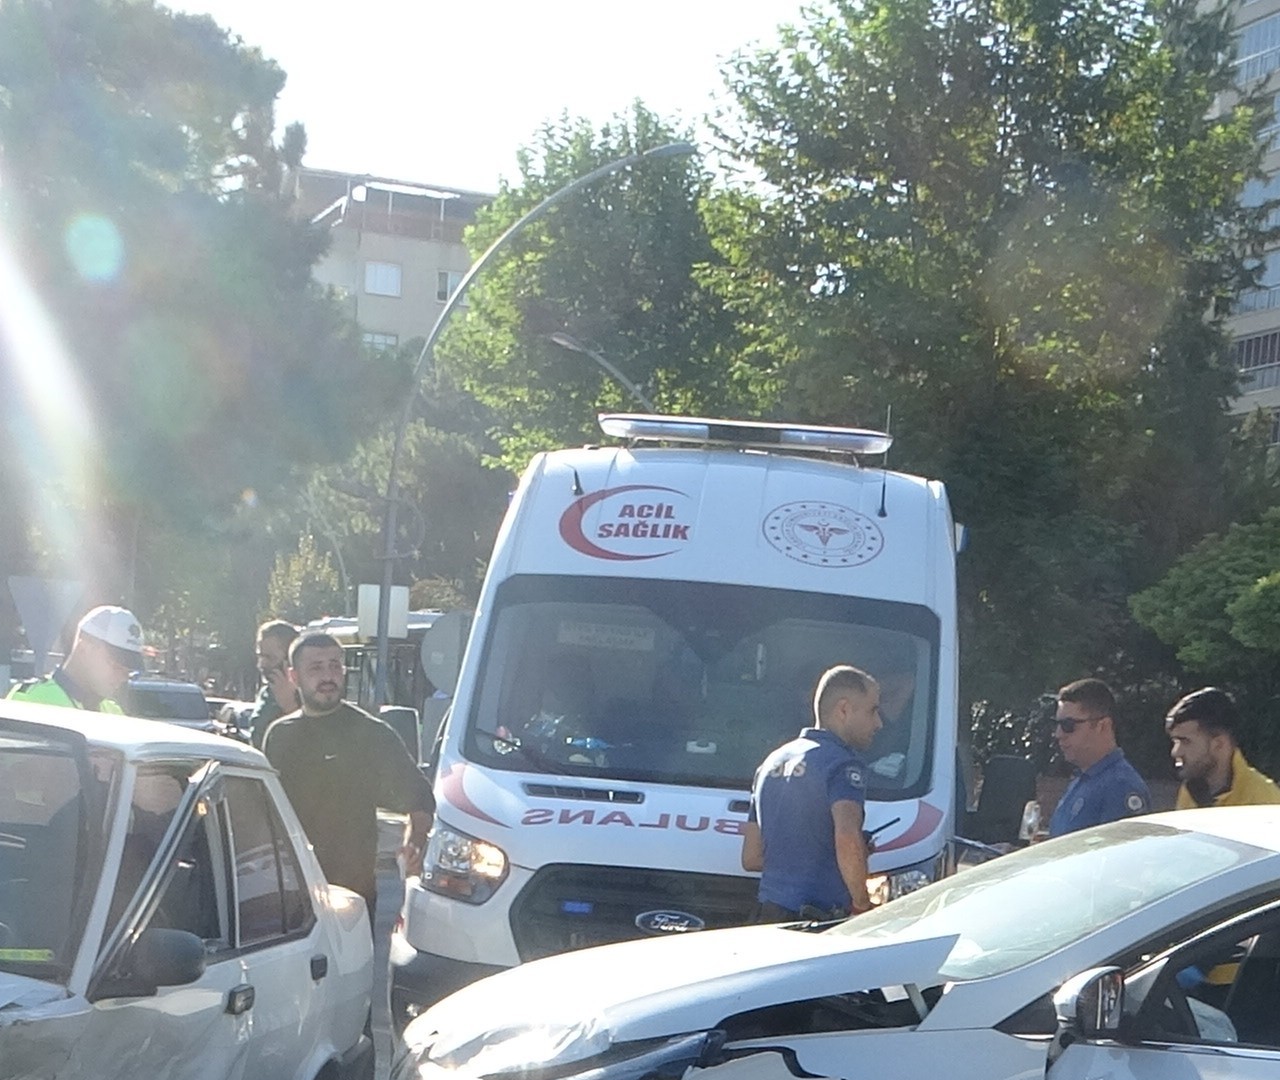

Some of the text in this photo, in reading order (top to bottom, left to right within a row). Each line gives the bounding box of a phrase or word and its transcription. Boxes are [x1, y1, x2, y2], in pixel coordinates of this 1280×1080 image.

[618, 502, 675, 519] ACİL
[597, 520, 691, 540] SAĞLIK
[650, 913, 690, 932] Ford
